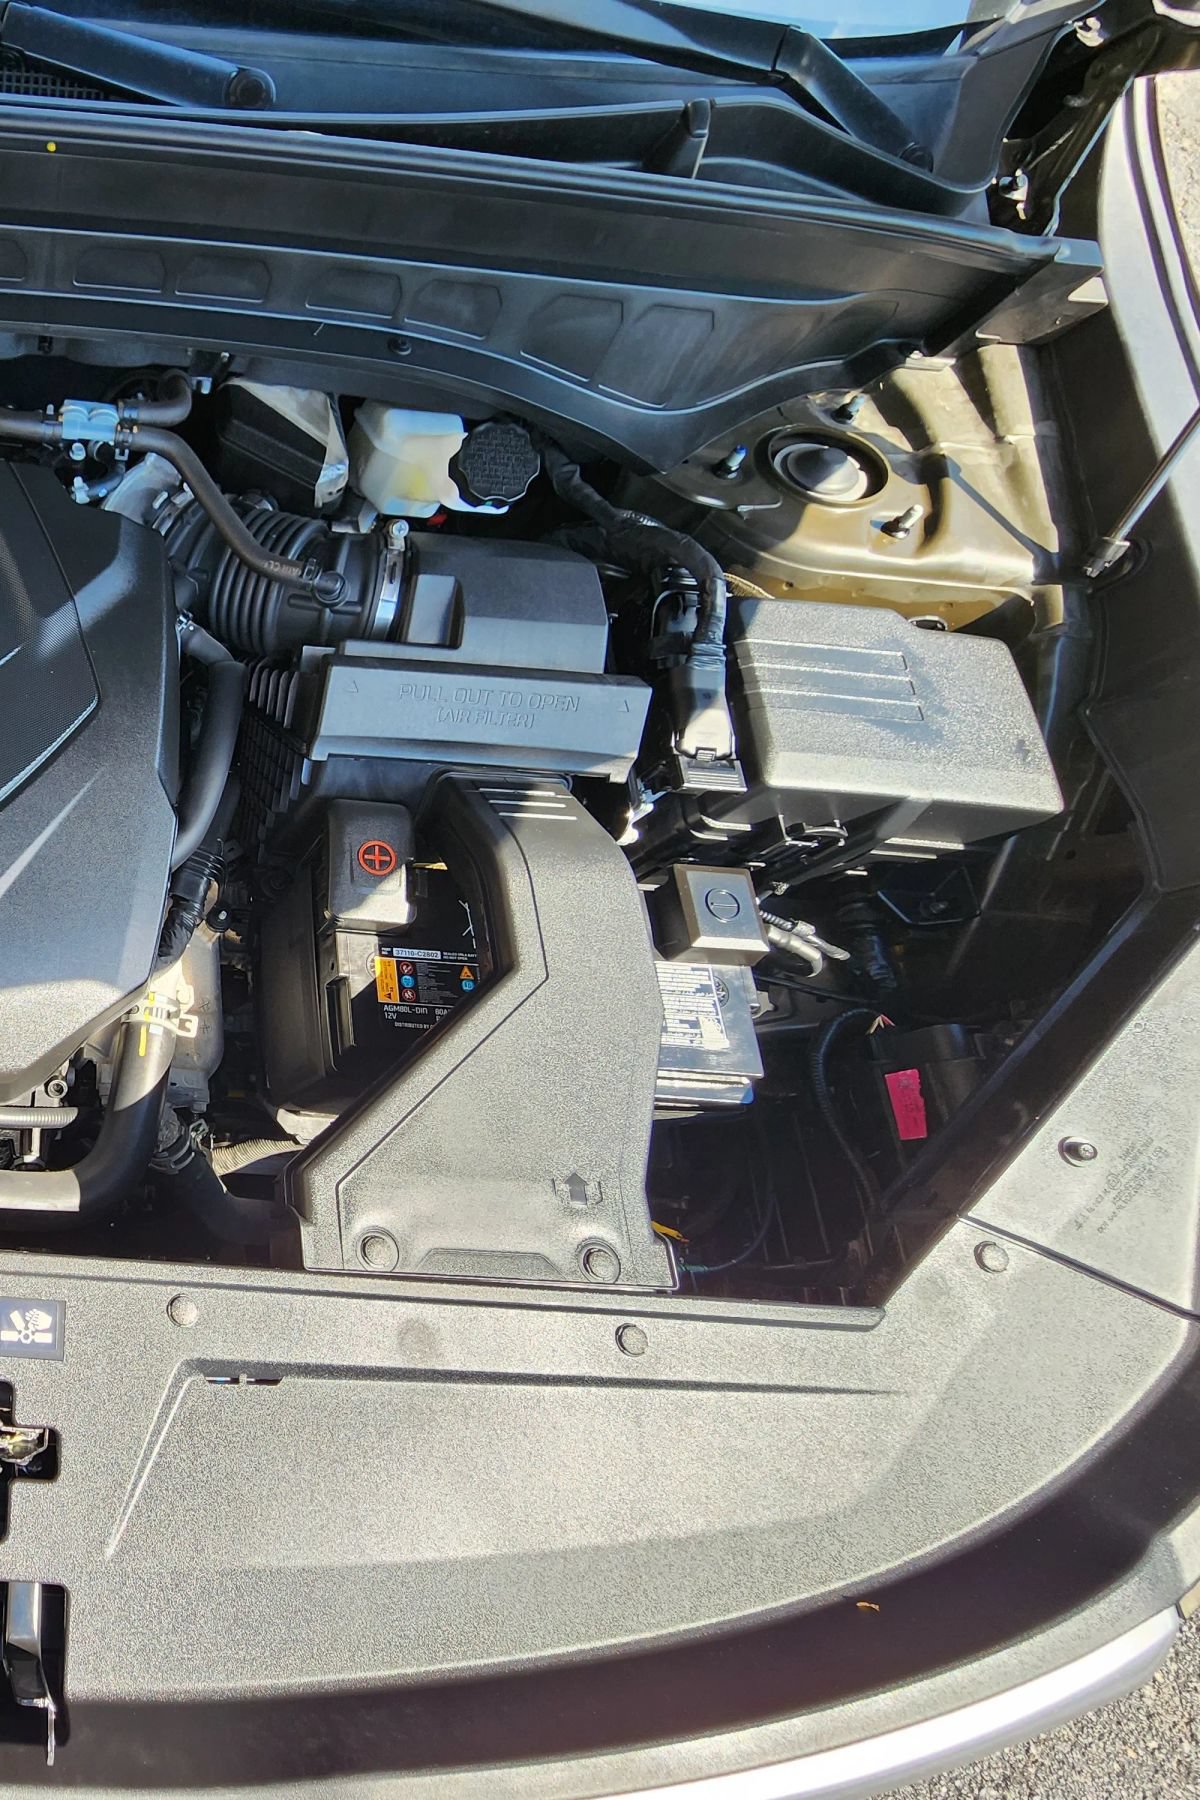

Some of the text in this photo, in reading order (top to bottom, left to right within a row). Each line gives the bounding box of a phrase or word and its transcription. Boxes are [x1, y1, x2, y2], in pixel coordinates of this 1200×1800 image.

[399, 683, 580, 713] PULL OUT TO OPEN
